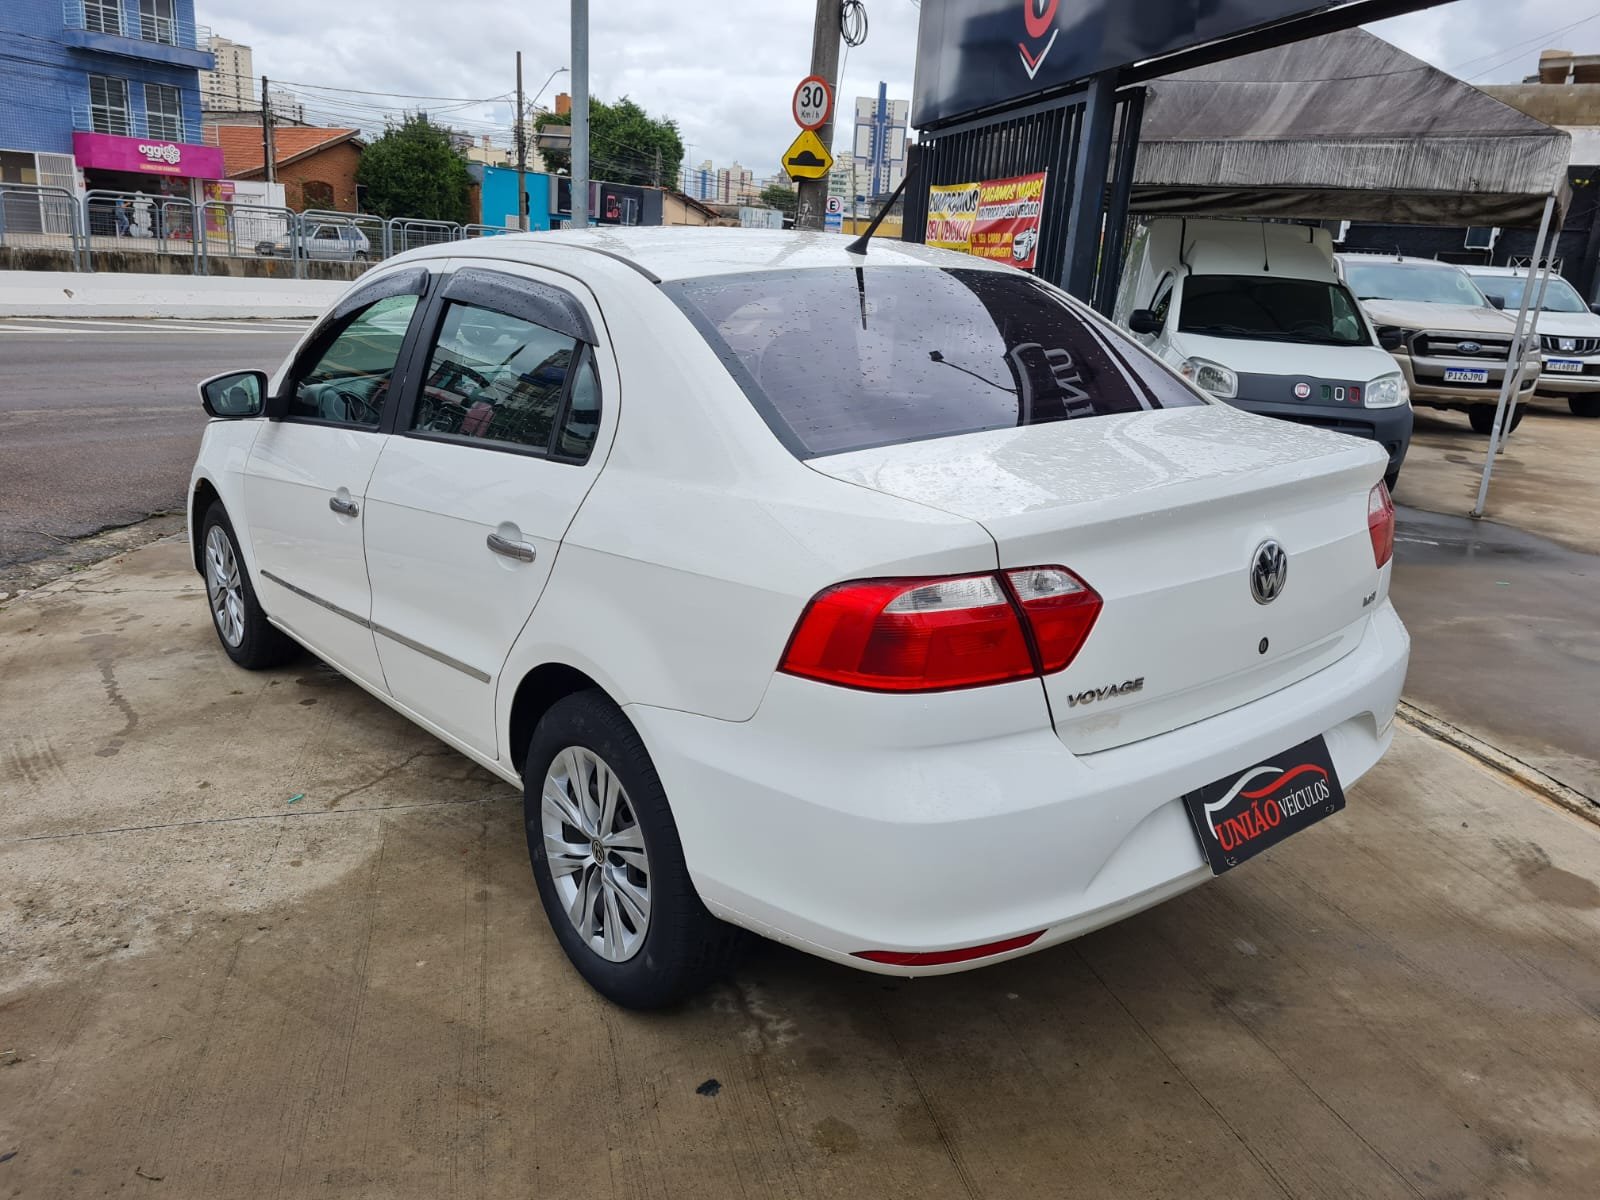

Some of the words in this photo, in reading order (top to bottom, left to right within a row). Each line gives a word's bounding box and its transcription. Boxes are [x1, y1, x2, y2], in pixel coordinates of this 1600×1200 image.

[801, 86, 824, 108] 30
[138, 143, 164, 158] oggi
[928, 189, 979, 213] COMPRAMOS
[980, 184, 1016, 203] PAGAMOS
[830, 200, 837, 210] E
[926, 219, 940, 241] SEU
[1066, 677, 1145, 708] VOYAGE
[1215, 800, 1281, 851] UNIÃO
[1278, 778, 1330, 819] VEÍCULOS
